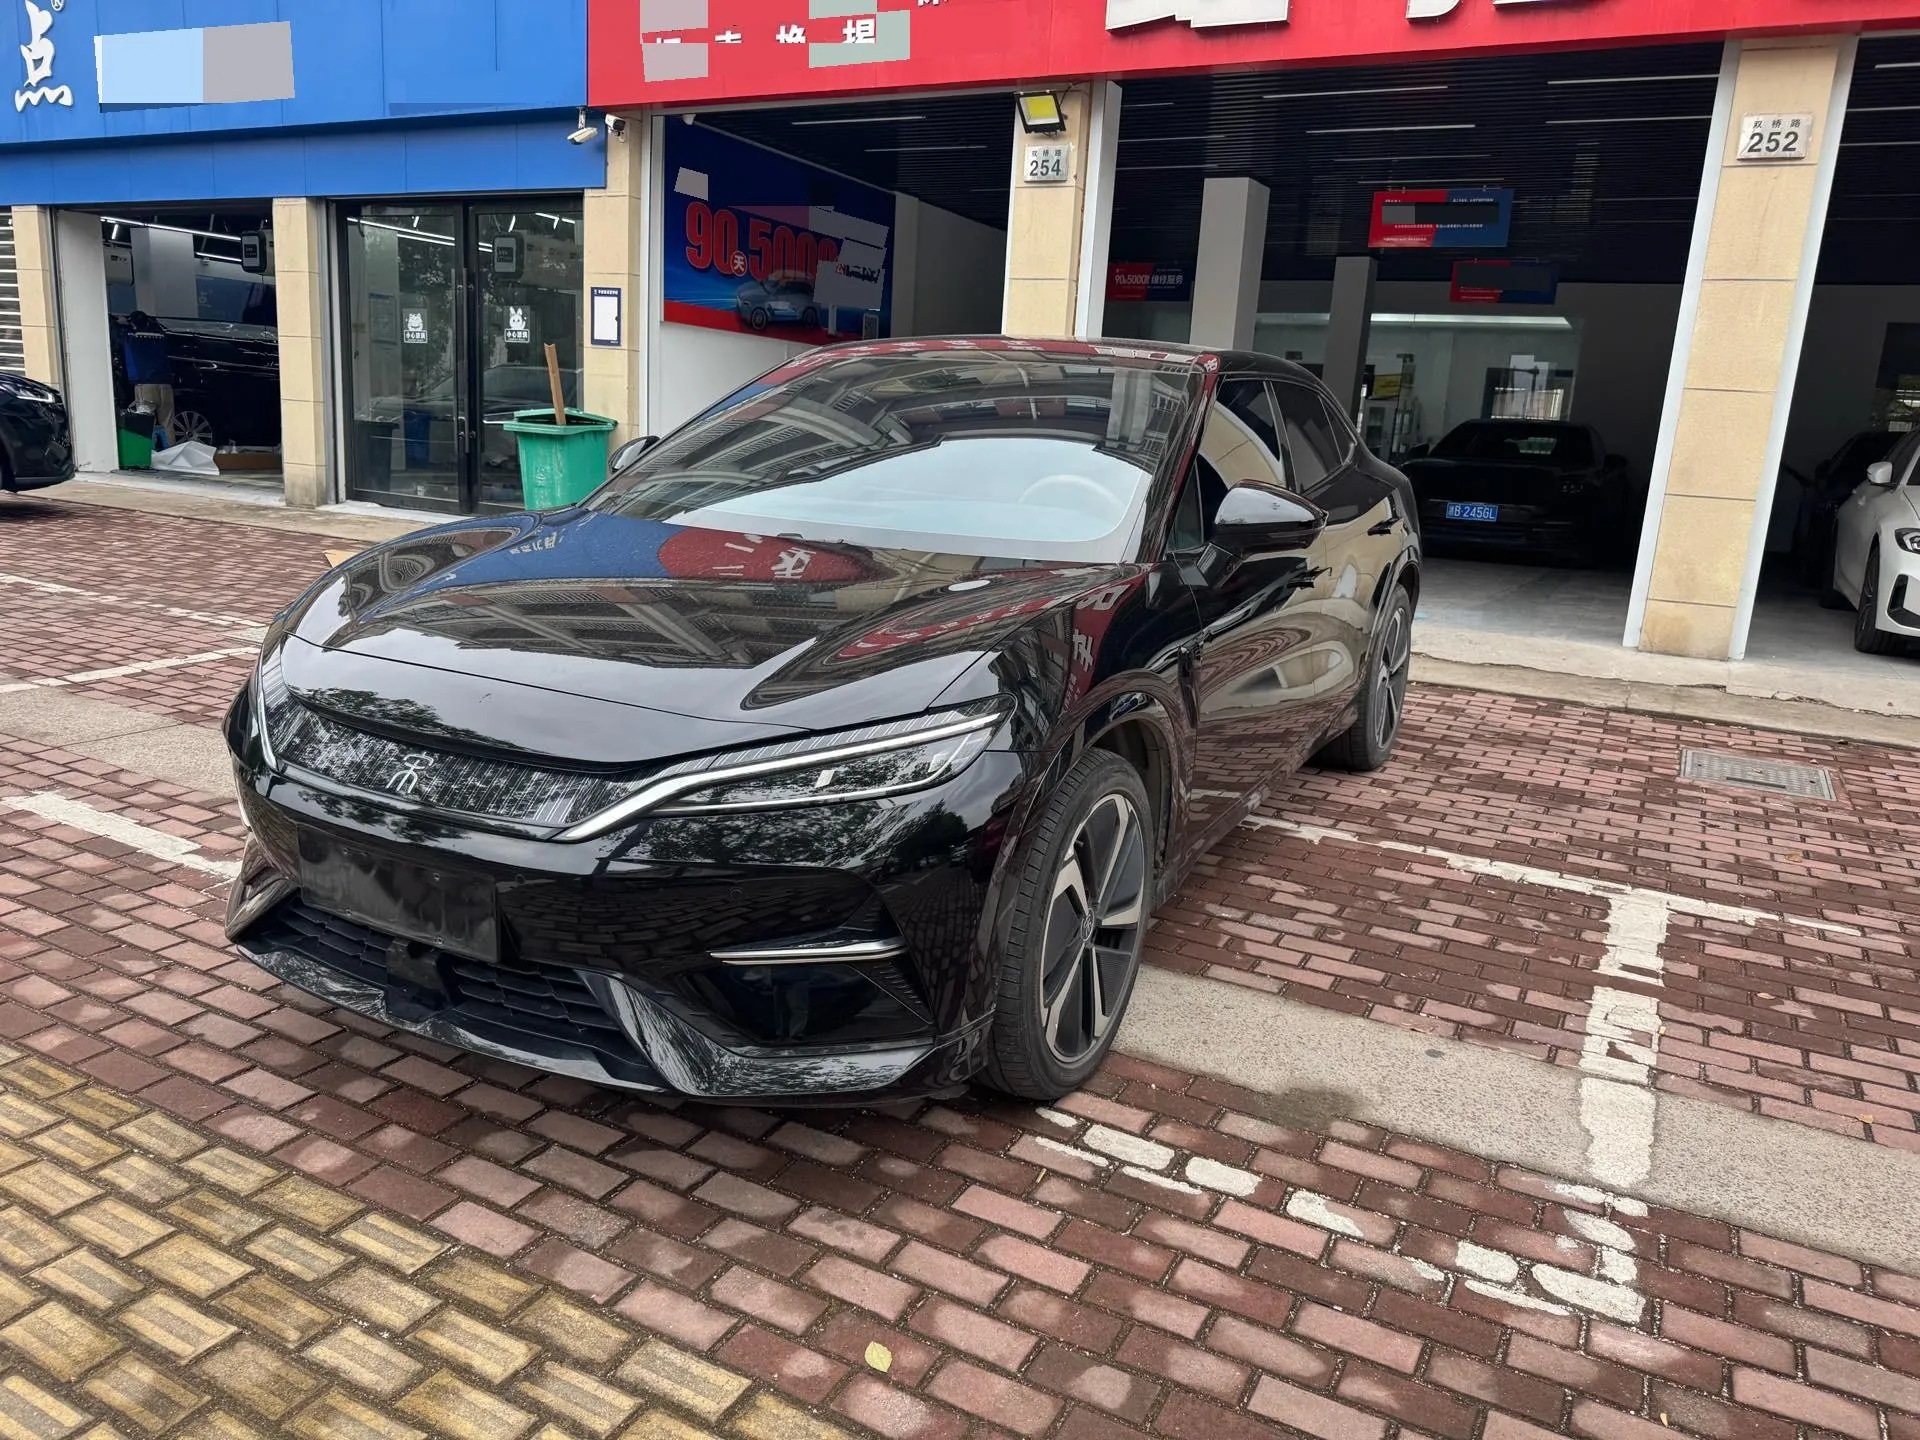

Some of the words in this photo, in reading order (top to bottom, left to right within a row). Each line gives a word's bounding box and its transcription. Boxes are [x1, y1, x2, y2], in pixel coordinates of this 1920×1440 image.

[1752, 119, 1801, 128] 双桥路
[1747, 131, 1799, 152] 252
[1030, 159, 1061, 176] 254
